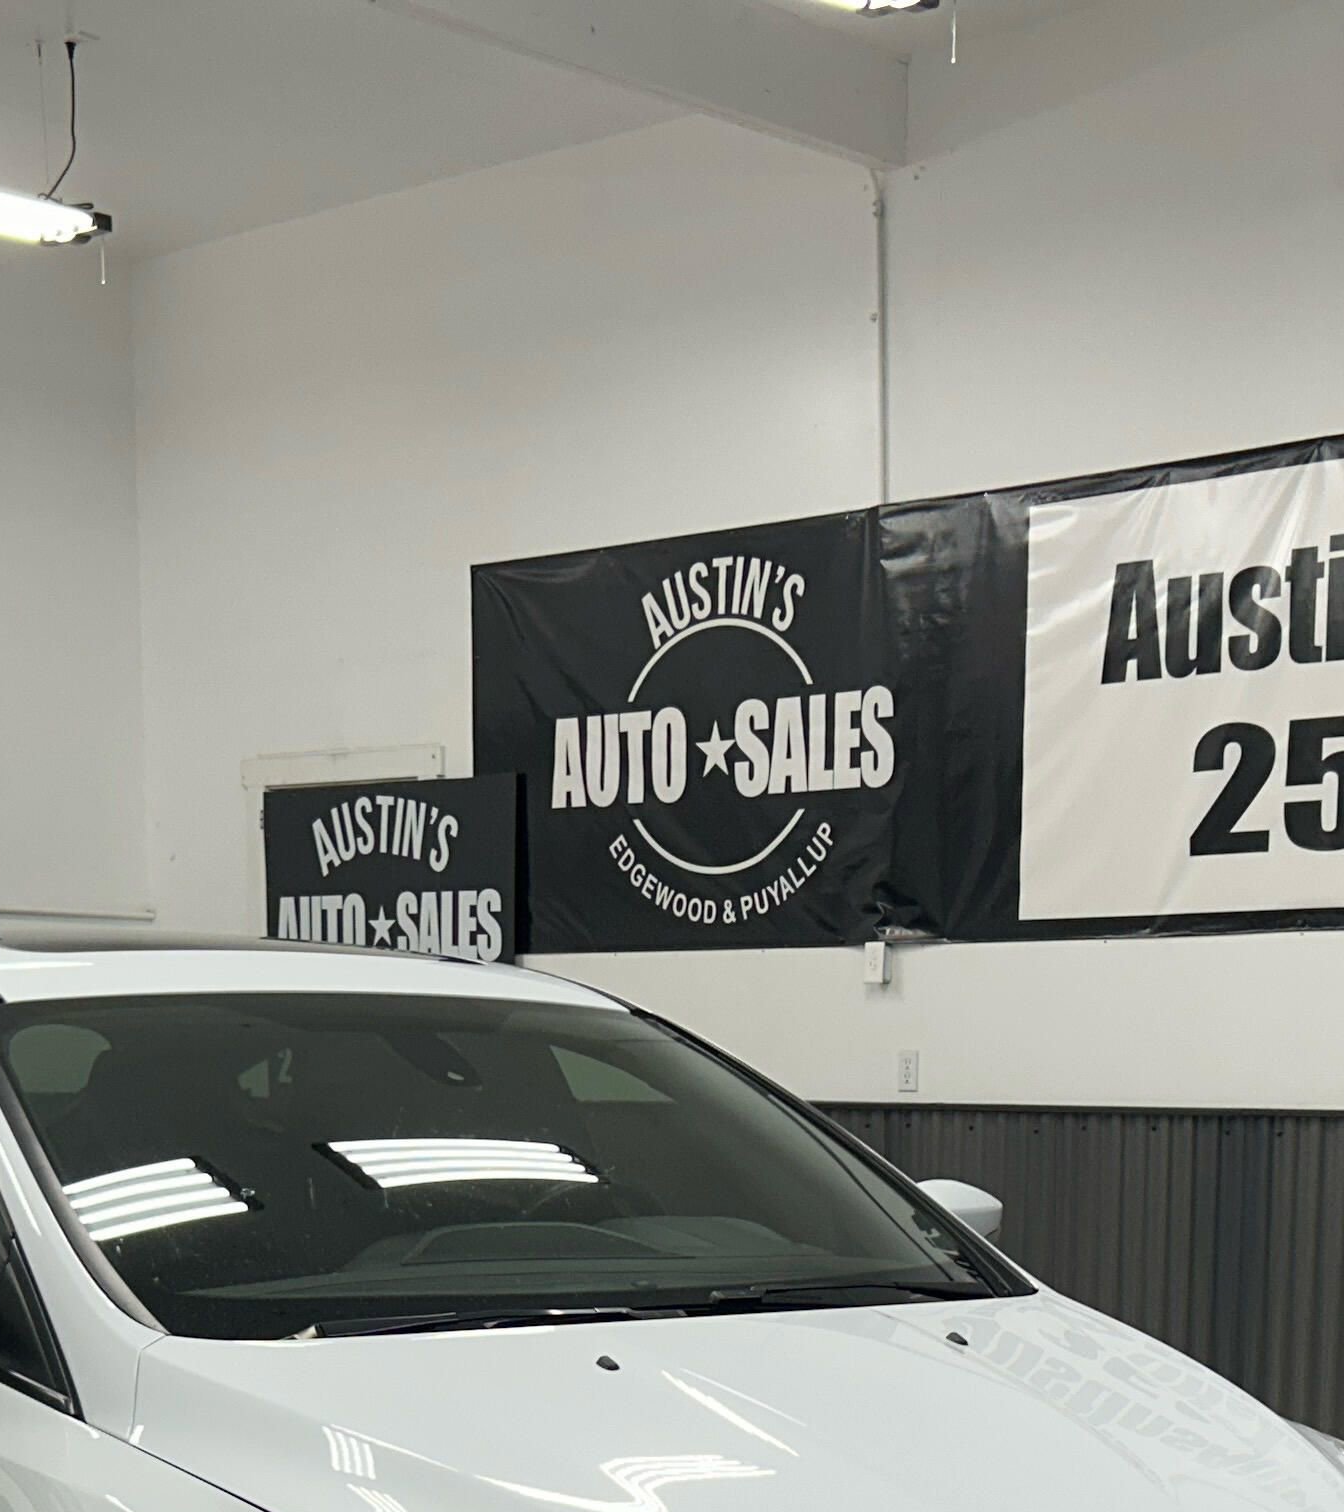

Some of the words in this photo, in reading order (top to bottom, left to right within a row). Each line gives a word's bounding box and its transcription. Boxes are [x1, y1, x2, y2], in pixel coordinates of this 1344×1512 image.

[641, 555, 805, 650] AUSTIN'S
[551, 706, 687, 809] AUTO
[734, 685, 895, 798] SALES
[312, 795, 459, 877] AUSTIN'S
[608, 834, 717, 924] EDGEWOOD
[722, 899, 737, 924] &
[740, 822, 834, 920] PUYALLUP
[396, 888, 503, 962] SALES
